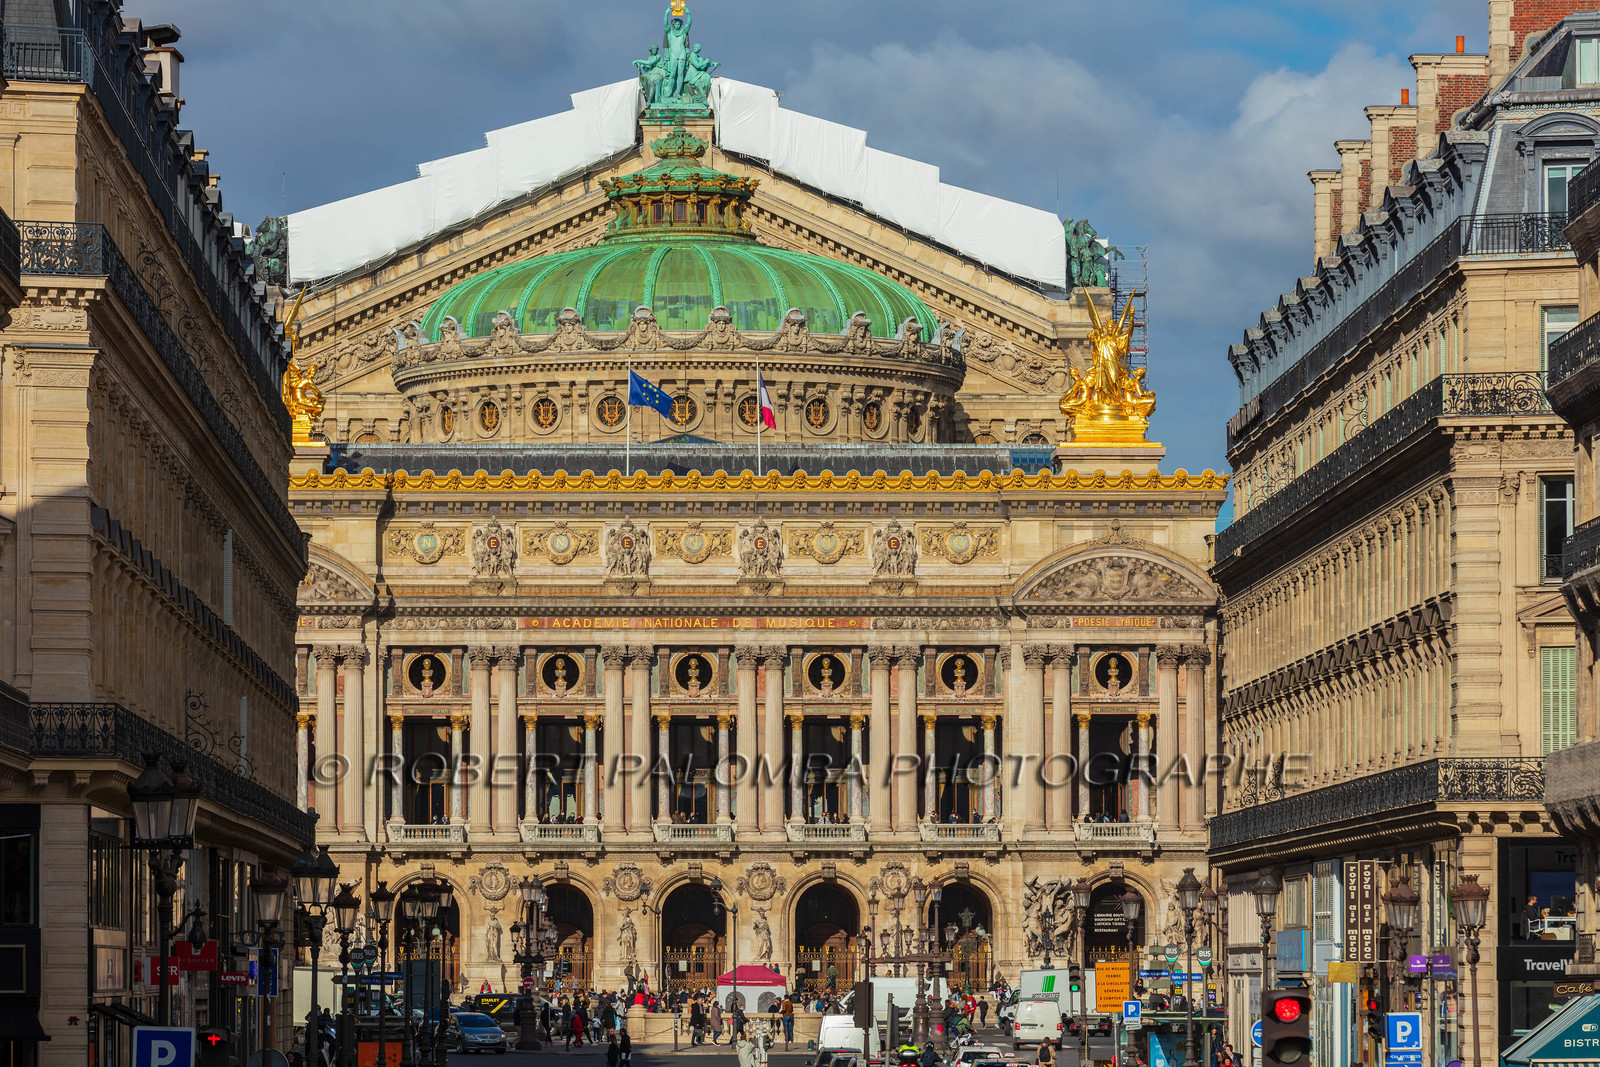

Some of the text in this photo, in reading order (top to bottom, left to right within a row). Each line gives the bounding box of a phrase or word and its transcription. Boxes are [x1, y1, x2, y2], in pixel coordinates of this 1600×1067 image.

[423, 538, 431, 548] N
[490, 539, 497, 548] E
[556, 538, 565, 548] N
[624, 539, 630, 548] E
[689, 537, 698, 548] N
[757, 539, 764, 548] E
[823, 538, 831, 548] N
[890, 539, 897, 548] E
[955, 538, 964, 548] N
[551, 617, 837, 628] ACADEMIE NATIONALE DE MUSIQUE
[1078, 617, 1152, 628] POESIE LYRIQUE
[1347, 866, 1358, 959] royal air maroc
[1362, 864, 1373, 959] royal air maroc
[351, 952, 364, 960] BUS
[1165, 947, 1178, 955] BUS
[1556, 982, 1593, 995] Café
[1128, 1005, 1136, 1015] P
[1396, 1021, 1412, 1043] P
[150, 1039, 177, 1067] P
